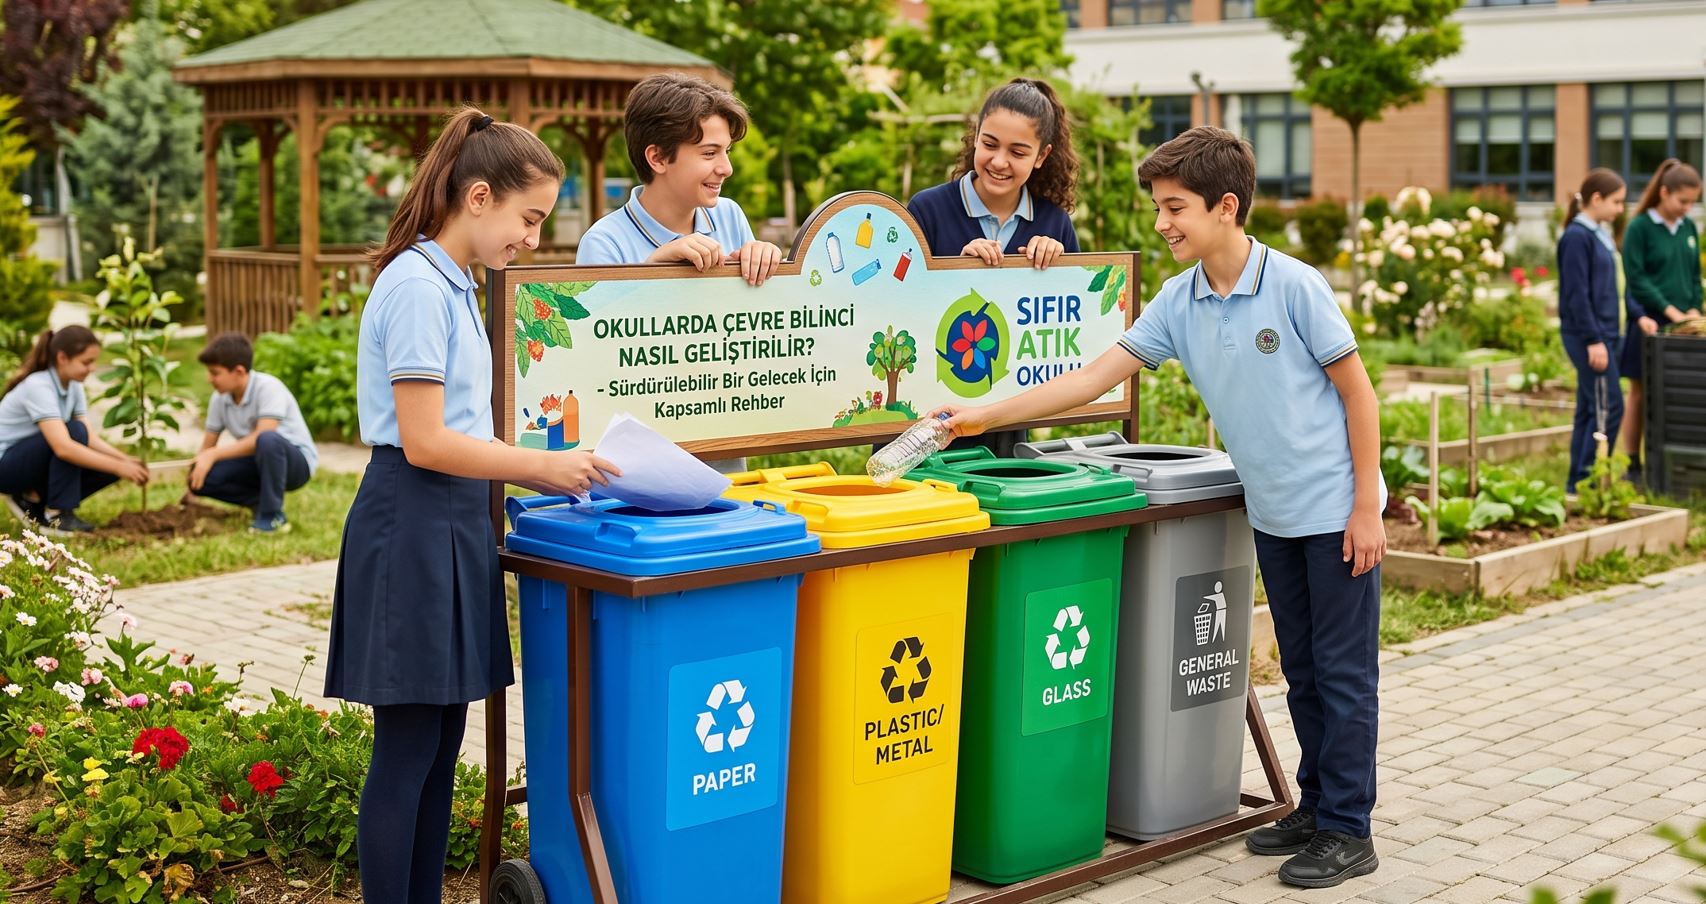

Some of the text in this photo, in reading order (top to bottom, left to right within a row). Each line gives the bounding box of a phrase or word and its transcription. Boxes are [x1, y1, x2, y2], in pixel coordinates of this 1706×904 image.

[593, 304, 855, 339] OKULLARDA ÇEVRE BİLİNCİ
[1016, 295, 1081, 325] SIFIR
[619, 335, 815, 368] NASIL GELİŞTİRİLİR?
[1016, 327, 1081, 360] ATIK
[608, 373, 719, 398] Sürdürülebilir
[722, 370, 744, 389] Bir
[748, 366, 806, 386] Gelecek
[810, 364, 836, 384] İçin
[1016, 362, 1082, 386] OKU
[654, 394, 785, 420] Kapsamlı Rehber
[1178, 648, 1239, 677] GENERAL
[1042, 678, 1091, 706] GLASS
[1186, 671, 1232, 697] WASTE
[864, 704, 945, 740] PLASTIC/
[875, 736, 933, 765] METAL
[692, 762, 756, 796] PAPER
